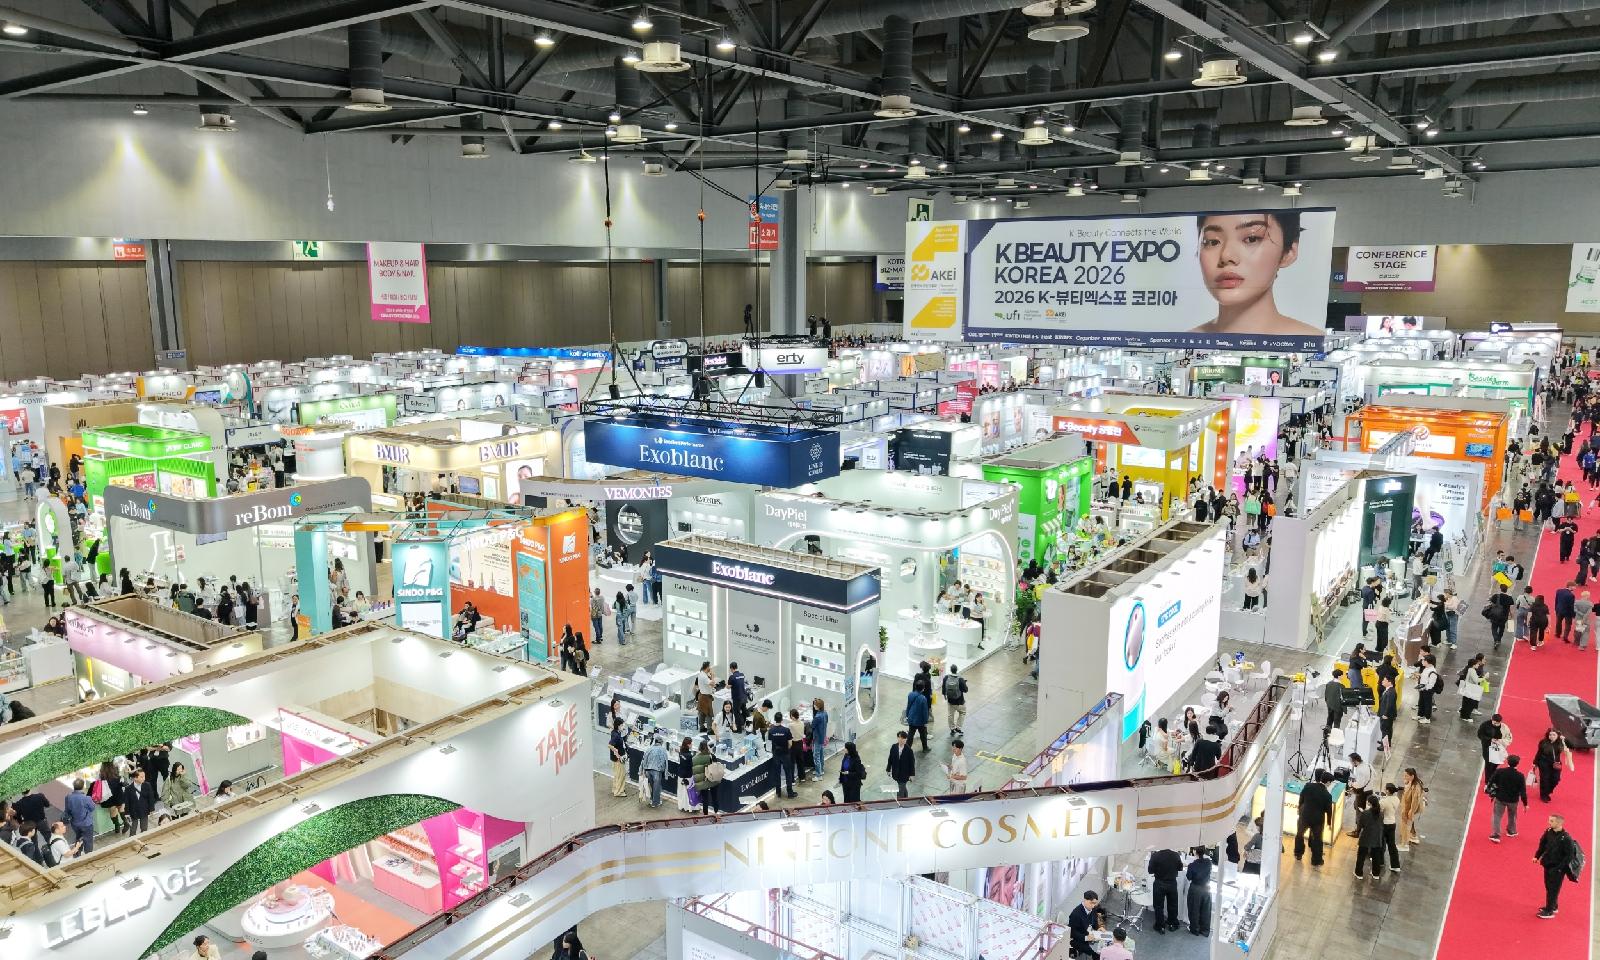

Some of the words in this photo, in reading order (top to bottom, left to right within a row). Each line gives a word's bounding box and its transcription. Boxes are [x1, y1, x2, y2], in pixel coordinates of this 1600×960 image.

[1105, 228, 1142, 237] Connects
[996, 244, 1012, 263] K
[1015, 242, 1108, 263] BEAUTY
[1111, 240, 1181, 263] EXPO
[1356, 250, 1427, 259] CONFERENCE
[931, 267, 957, 280] AKEI
[1373, 260, 1407, 269] STAGE
[995, 266, 1068, 284] KOREA
[1074, 265, 1125, 285] 2026
[994, 291, 1035, 304] 2026
[1038, 290, 1127, 306] K-뷰티엑스포
[1131, 290, 1178, 306] 코리아
[377, 444, 410, 463] BYUR
[480, 442, 520, 462] BYUR
[639, 445, 725, 472] Exoblanc
[604, 486, 673, 500] VEMONTES
[234, 504, 293, 526] reBom
[765, 504, 808, 522] DayPiel
[712, 561, 775, 586] Exoblanc
[397, 588, 424, 597] SINDO
[425, 588, 443, 596] P&G
[536, 703, 578, 767] TAKE
